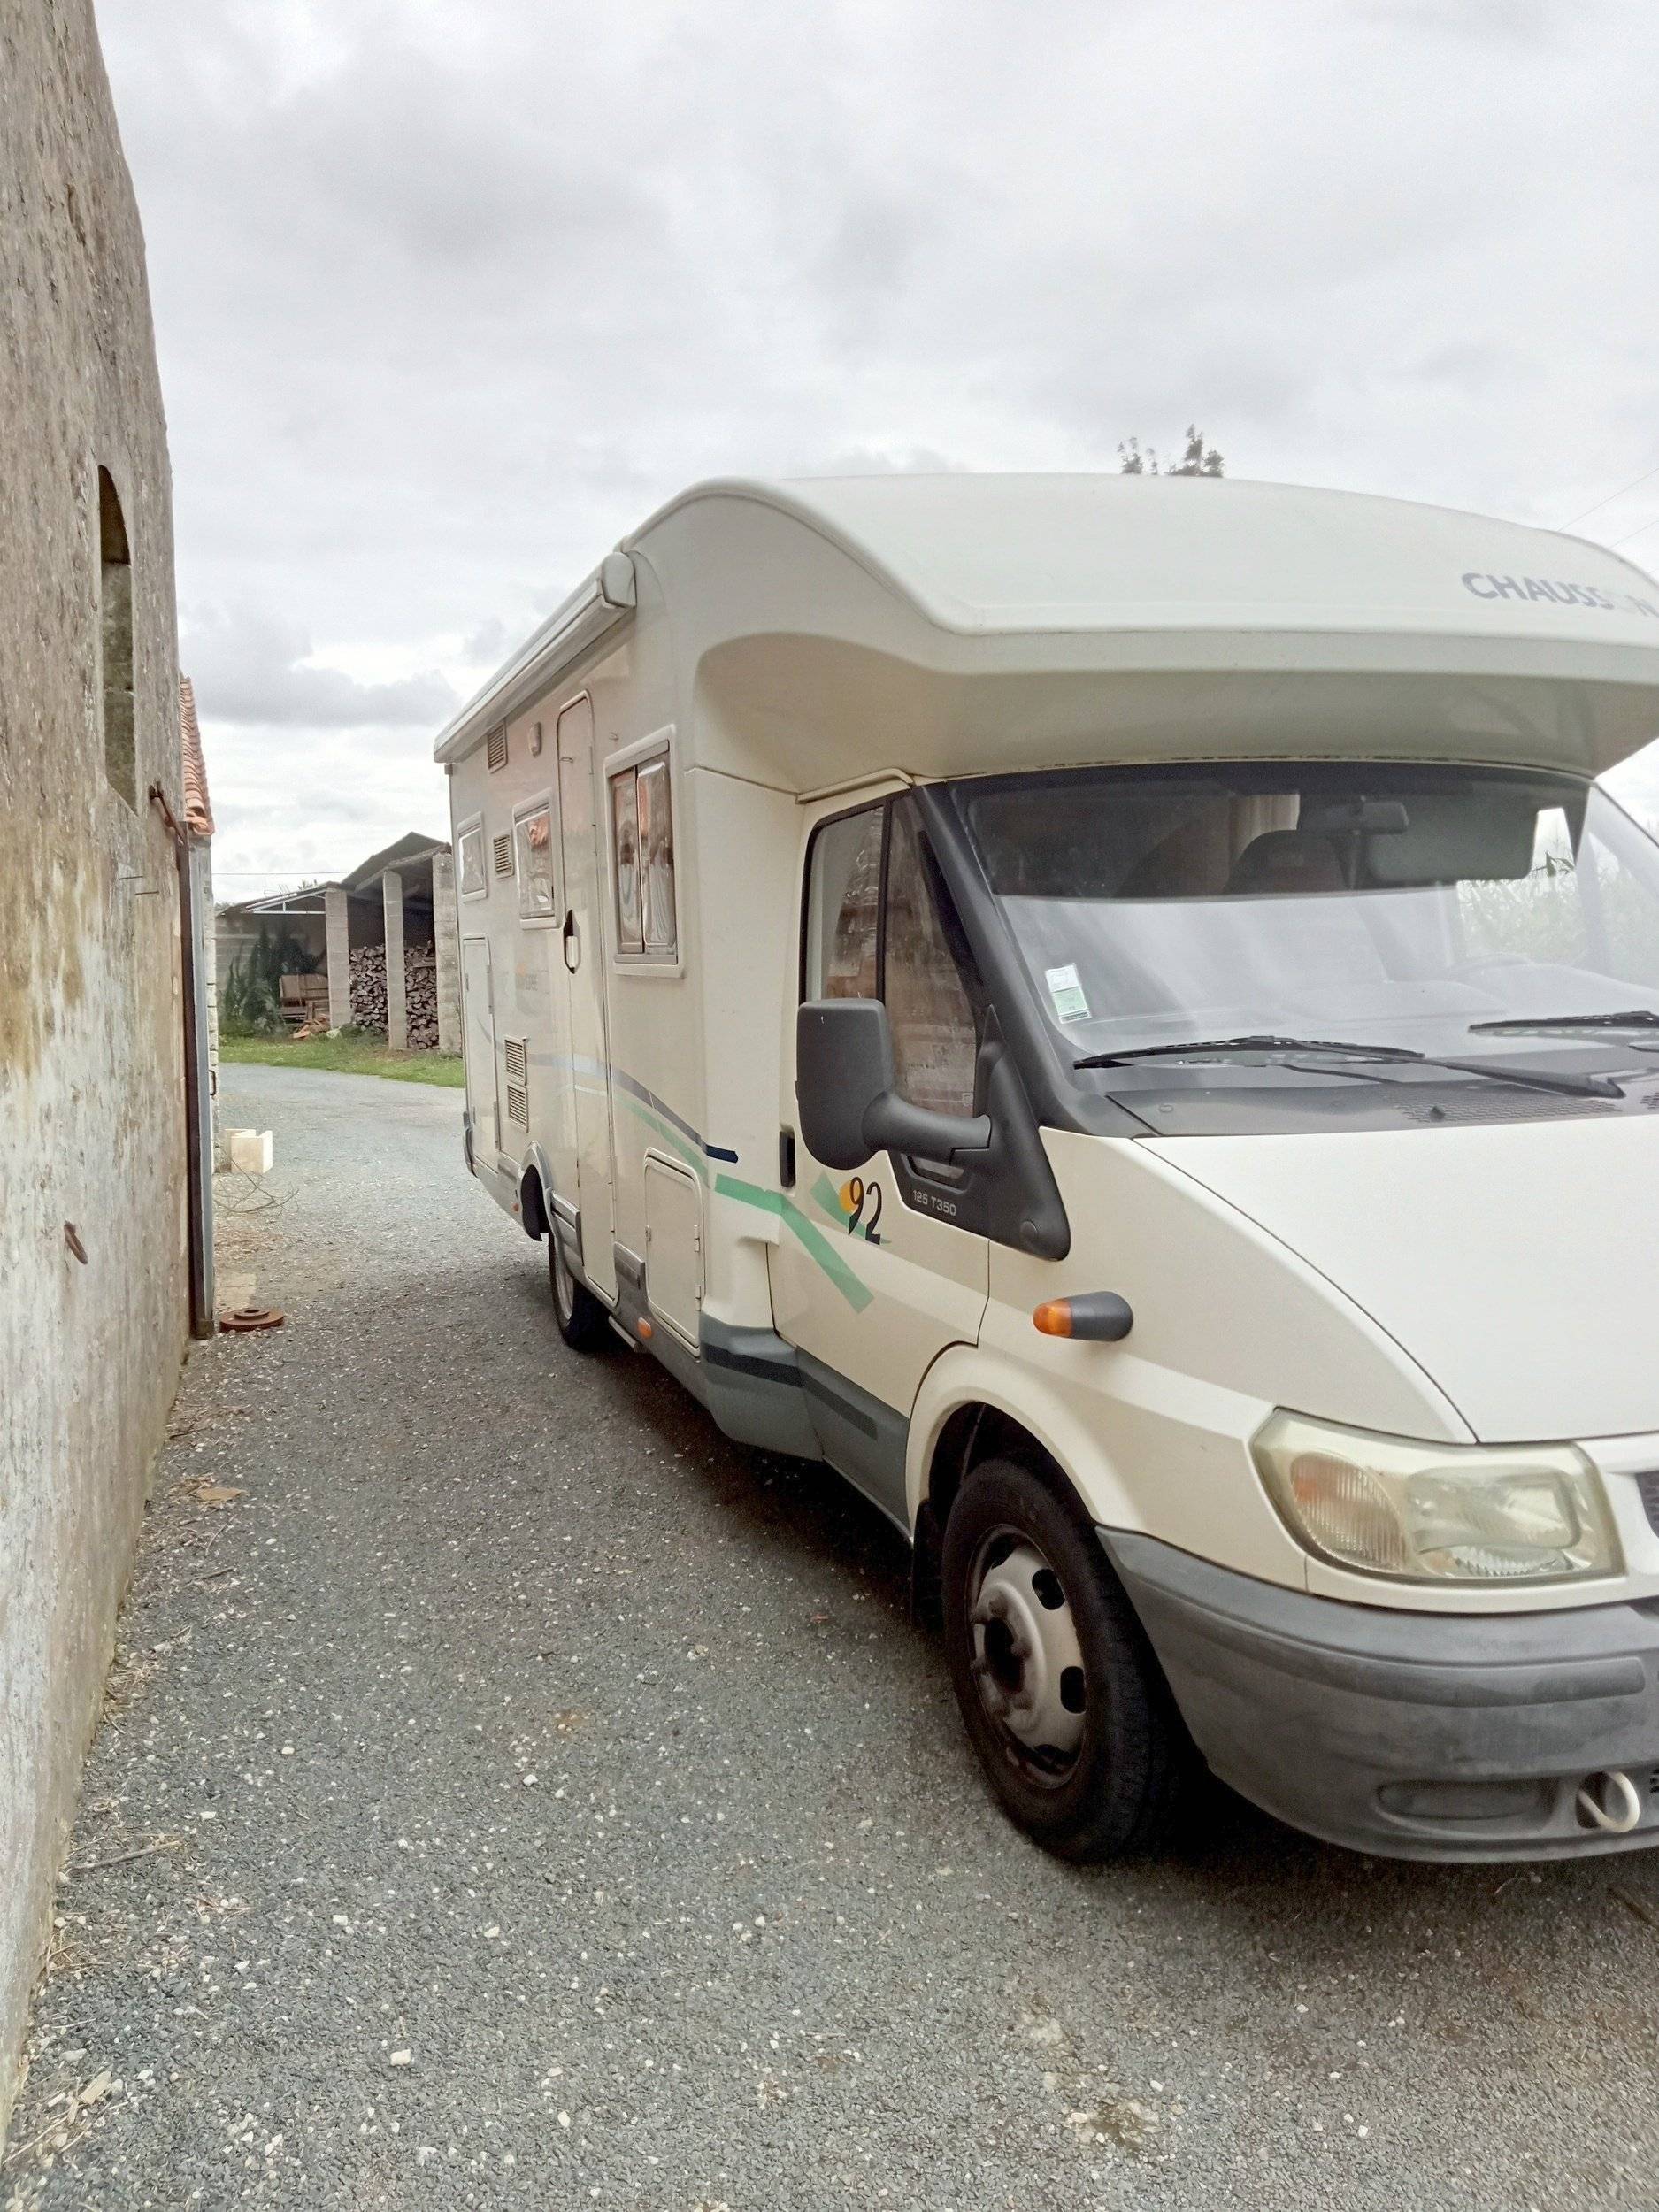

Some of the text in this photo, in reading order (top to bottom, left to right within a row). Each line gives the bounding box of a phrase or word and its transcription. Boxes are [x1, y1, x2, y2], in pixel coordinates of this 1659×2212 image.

[848, 1176, 882, 1246] 92
[912, 1189, 956, 1217] 125 T350
